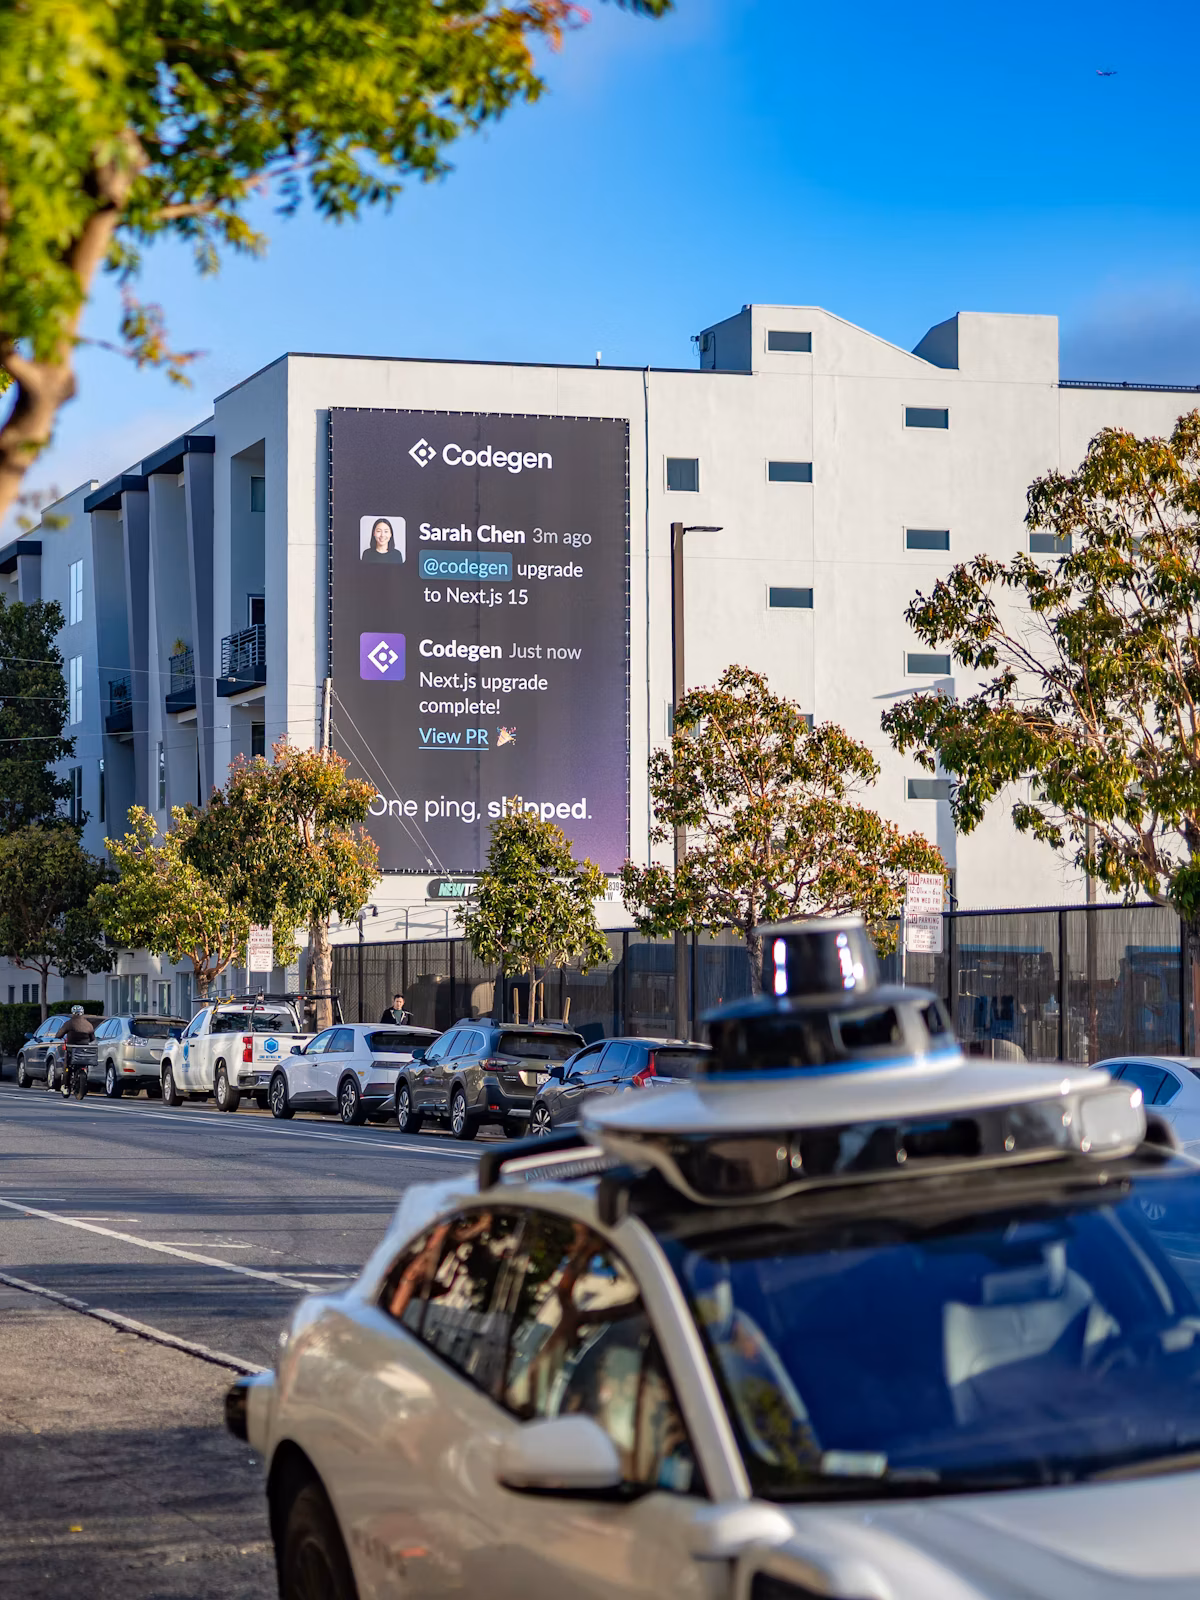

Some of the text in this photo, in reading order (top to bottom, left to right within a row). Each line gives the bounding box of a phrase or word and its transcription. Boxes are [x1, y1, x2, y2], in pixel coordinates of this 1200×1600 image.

[442, 443, 552, 473] Codegen
[419, 523, 592, 548] Sarah Chen 3m ago
[423, 558, 583, 580] @codegen upgrade
[424, 587, 528, 607] to Next.js 15
[419, 639, 582, 663] Codegen Just now
[419, 671, 549, 693] Next.js upgrade
[419, 698, 501, 717] complete!
[419, 728, 489, 745] View PR
[368, 794, 418, 817] One
[424, 795, 481, 823] ping,
[908, 873, 942, 886] NO PARKING
[908, 914, 939, 924] NO PARKING
